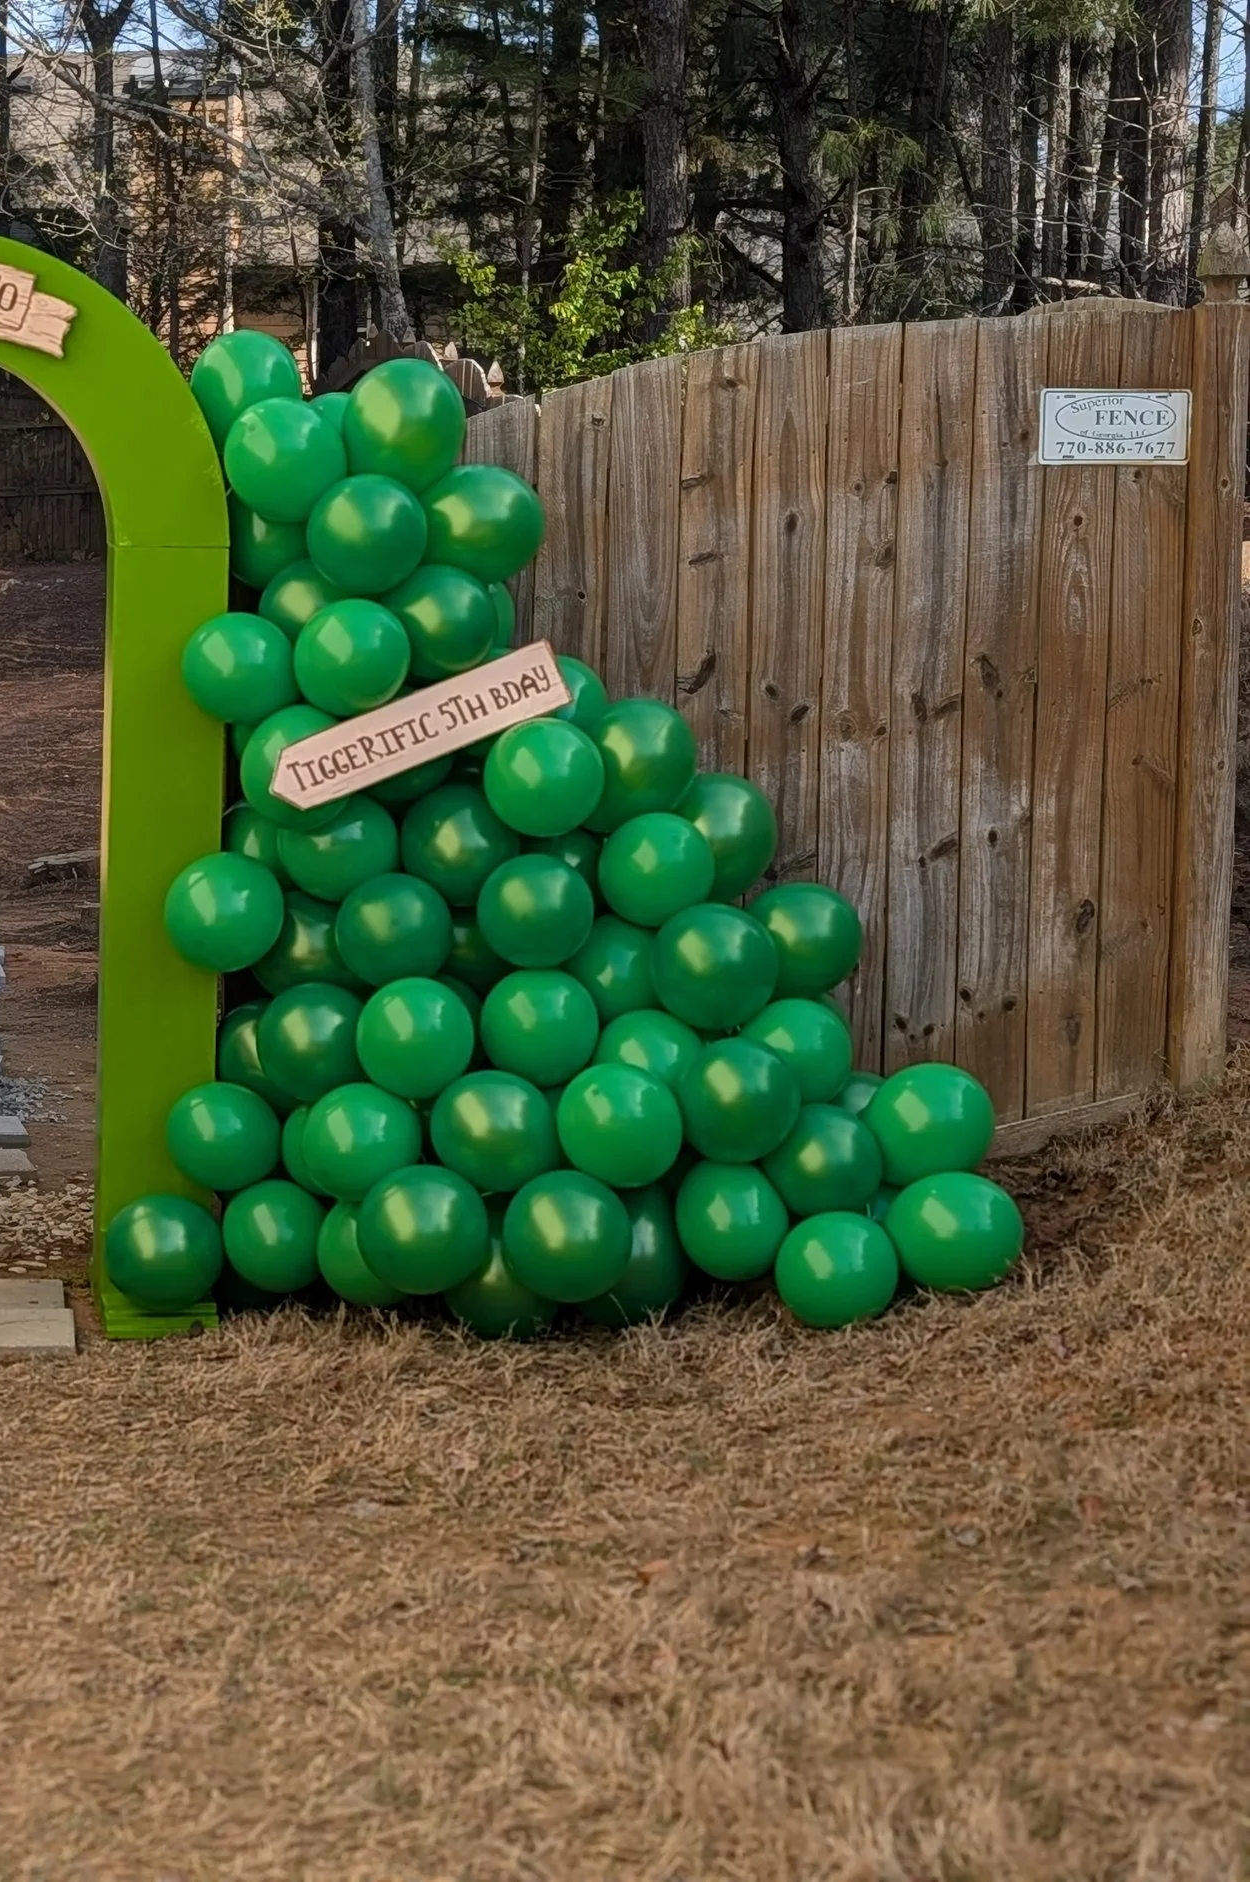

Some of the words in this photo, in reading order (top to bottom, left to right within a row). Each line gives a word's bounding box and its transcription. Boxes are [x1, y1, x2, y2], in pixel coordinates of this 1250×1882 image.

[1071, 397, 1125, 414] Superior
[1095, 410, 1170, 426] FENCE
[1056, 441, 1176, 455] 770-886-7677
[286, 712, 440, 792] TIGGERIFIC
[437, 693, 490, 732] 5TH
[488, 664, 552, 712] BDAY
